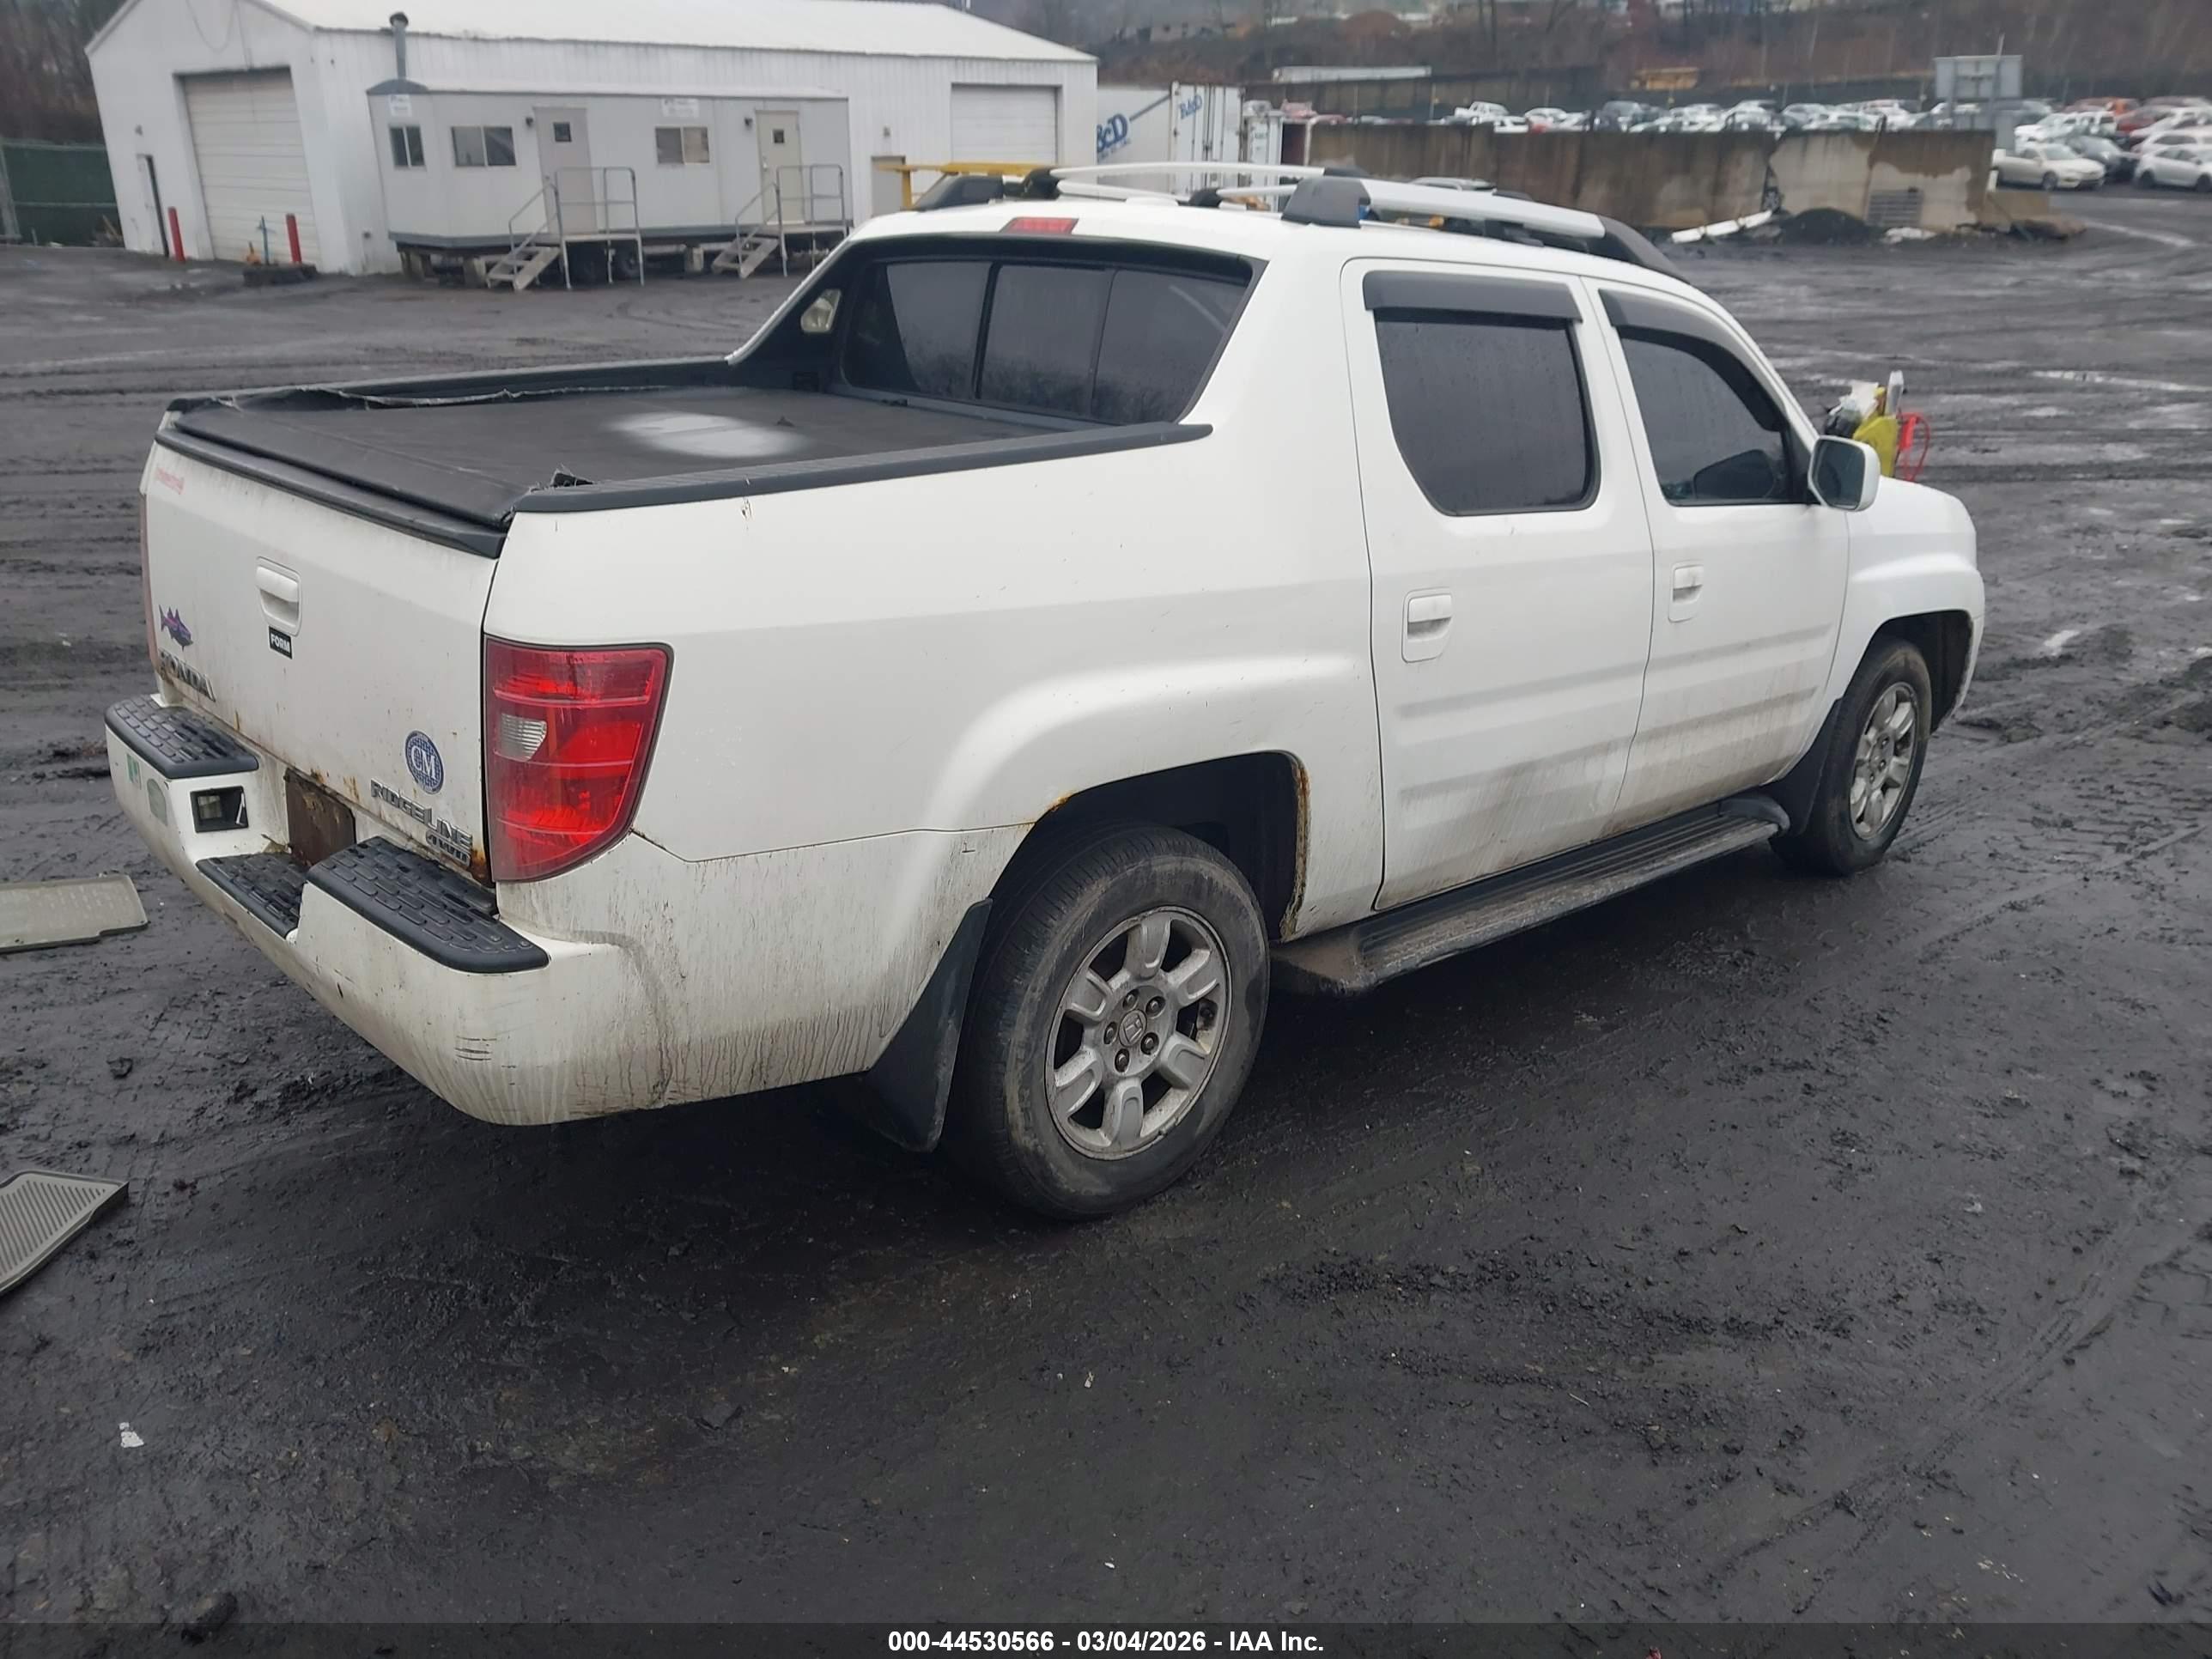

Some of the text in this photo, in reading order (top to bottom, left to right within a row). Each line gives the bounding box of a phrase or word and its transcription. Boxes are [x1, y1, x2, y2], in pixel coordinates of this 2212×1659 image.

[270, 634, 291, 654] FORM
[410, 745, 436, 781] CM
[370, 777, 472, 852] RIDGELINE
[425, 829, 471, 867] 4WD
